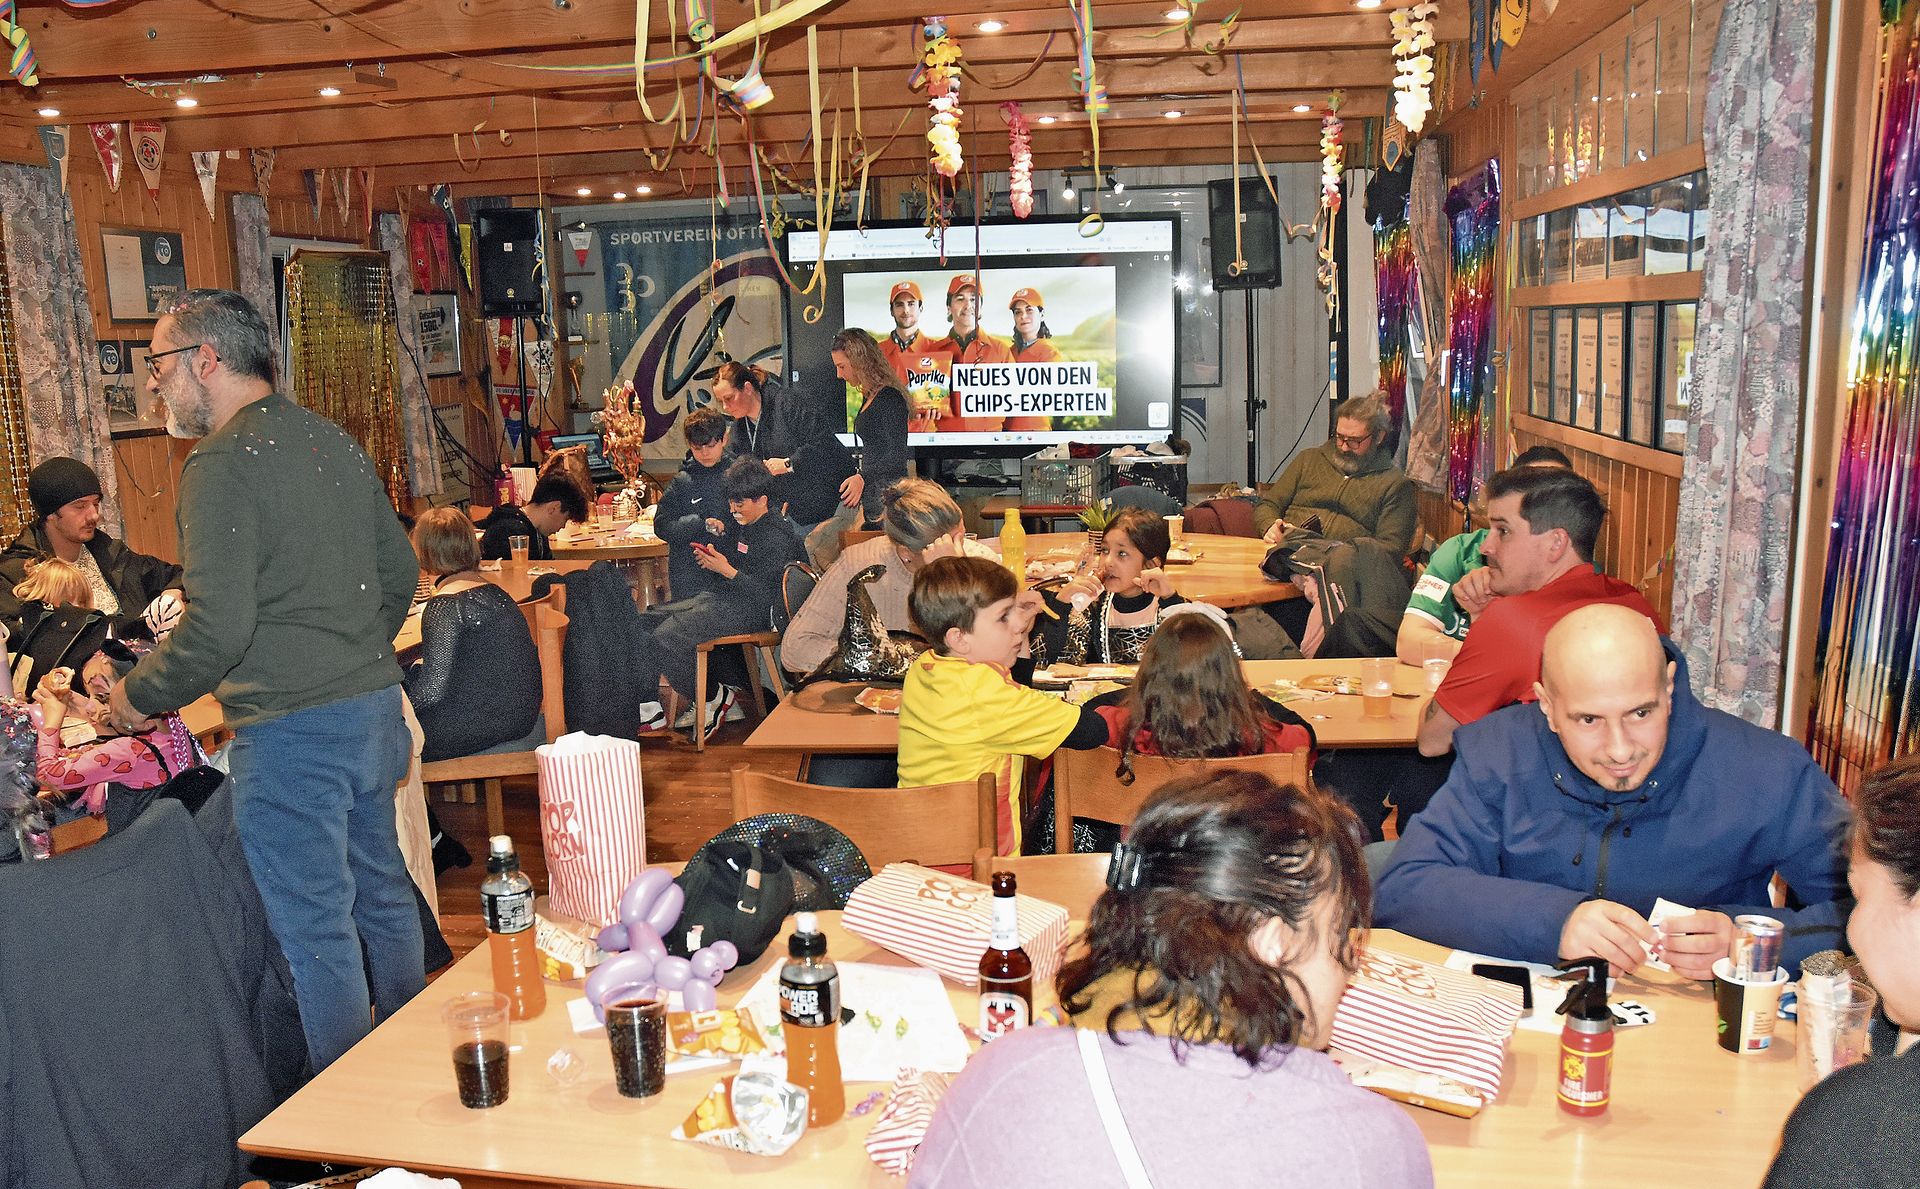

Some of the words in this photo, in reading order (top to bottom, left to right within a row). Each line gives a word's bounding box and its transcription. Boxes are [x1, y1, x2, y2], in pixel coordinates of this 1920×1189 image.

[610, 227, 722, 246] SPORTVEREIN
[906, 368, 946, 388] Paprika
[957, 367, 1011, 387] NEUES
[1015, 367, 1051, 386] VON
[1057, 366, 1092, 385] DEN
[964, 392, 1107, 413] CHIPS-EXPERTEN
[542, 800, 575, 833] OP
[547, 832, 585, 860] ORN
[780, 985, 819, 1003] OWER
